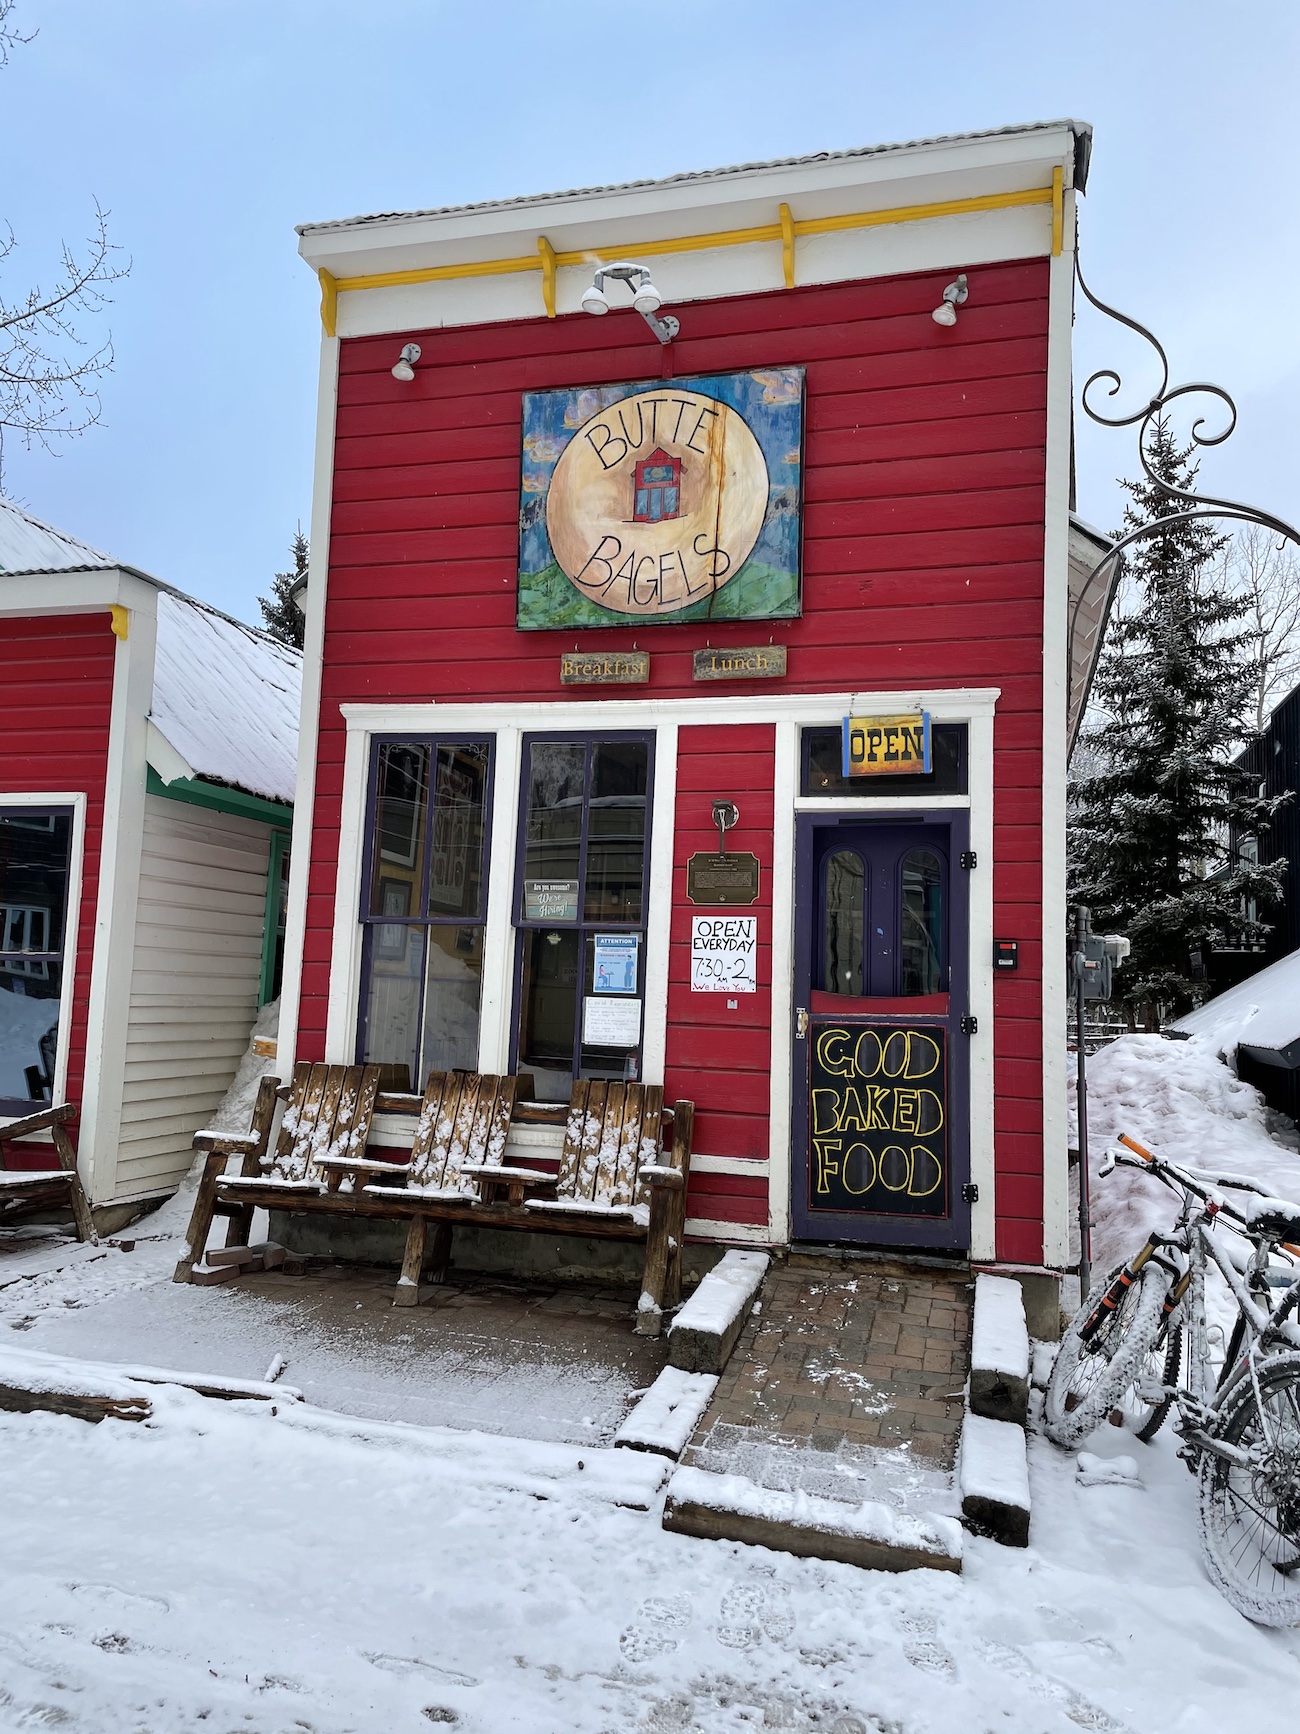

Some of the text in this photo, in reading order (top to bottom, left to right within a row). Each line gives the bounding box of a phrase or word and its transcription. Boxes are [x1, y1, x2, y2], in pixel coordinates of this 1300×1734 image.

[584, 399, 719, 470] BUTTE
[574, 533, 731, 606] BAGELS
[562, 660, 646, 676] Breakfast
[850, 727, 924, 763] OPEN
[539, 901, 568, 917] Hiring!
[693, 937, 755, 953] EVERYDAY
[697, 920, 752, 938] OPEN
[693, 983, 746, 991] We Love You
[817, 1029, 940, 1079] GOOD
[812, 1085, 943, 1136] BAKED
[813, 1138, 942, 1196] FOOD
